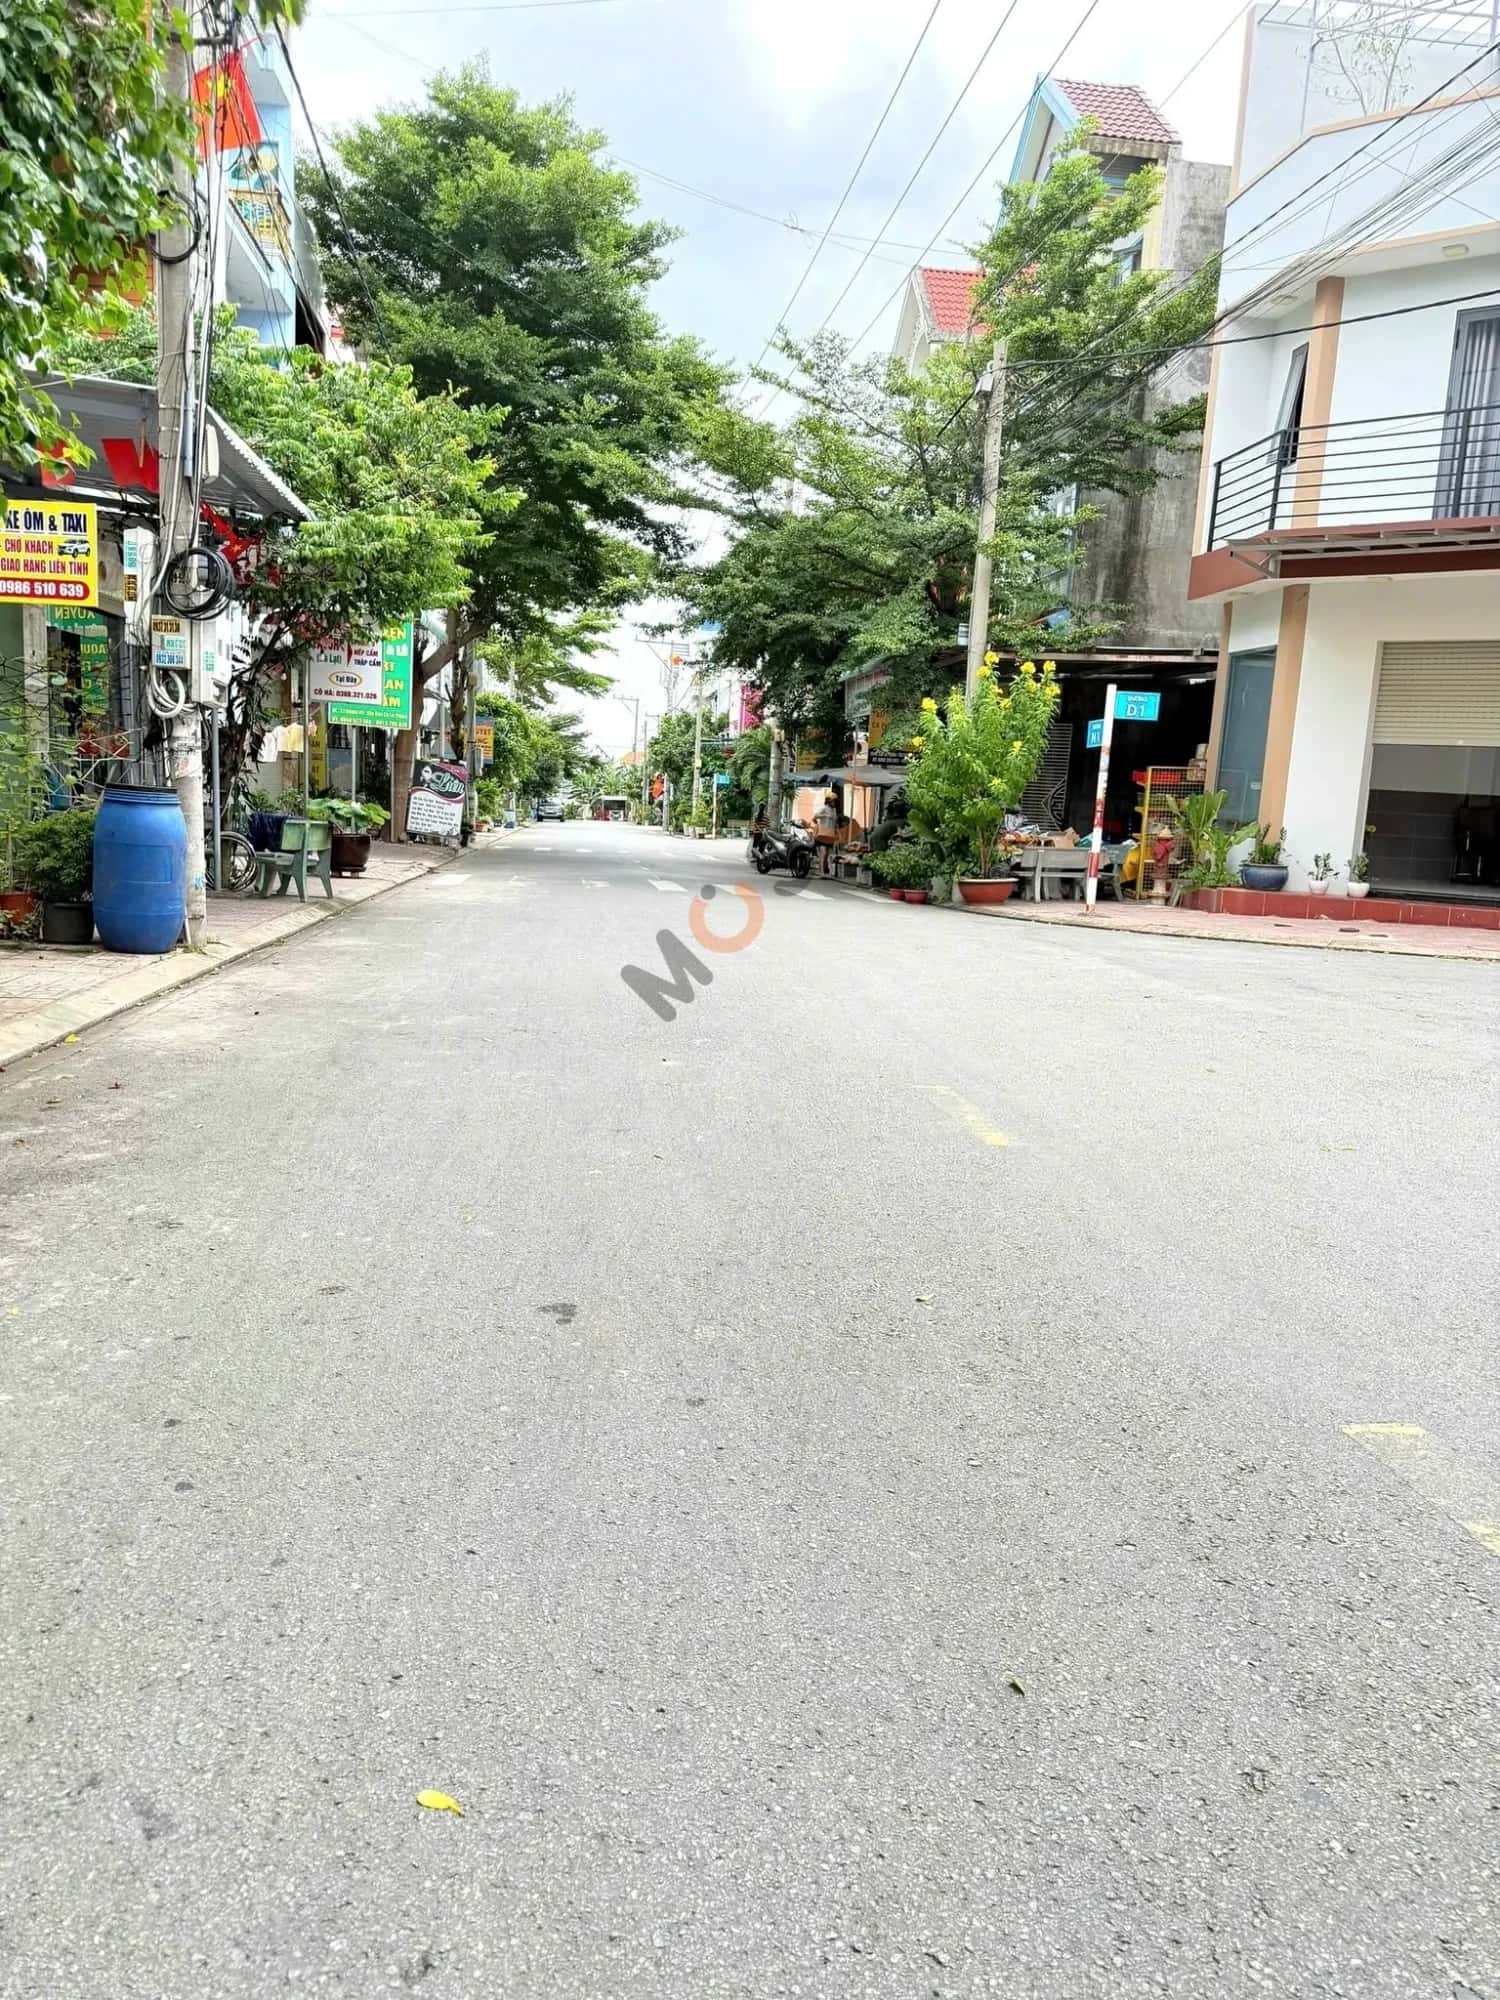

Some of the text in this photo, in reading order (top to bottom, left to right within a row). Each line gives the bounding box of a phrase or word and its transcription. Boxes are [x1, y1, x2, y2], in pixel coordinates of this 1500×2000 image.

[23, 507, 44, 531] ÔM
[61, 512, 87, 533] TAXI
[0, 580, 84, 598] 0986 510 639
